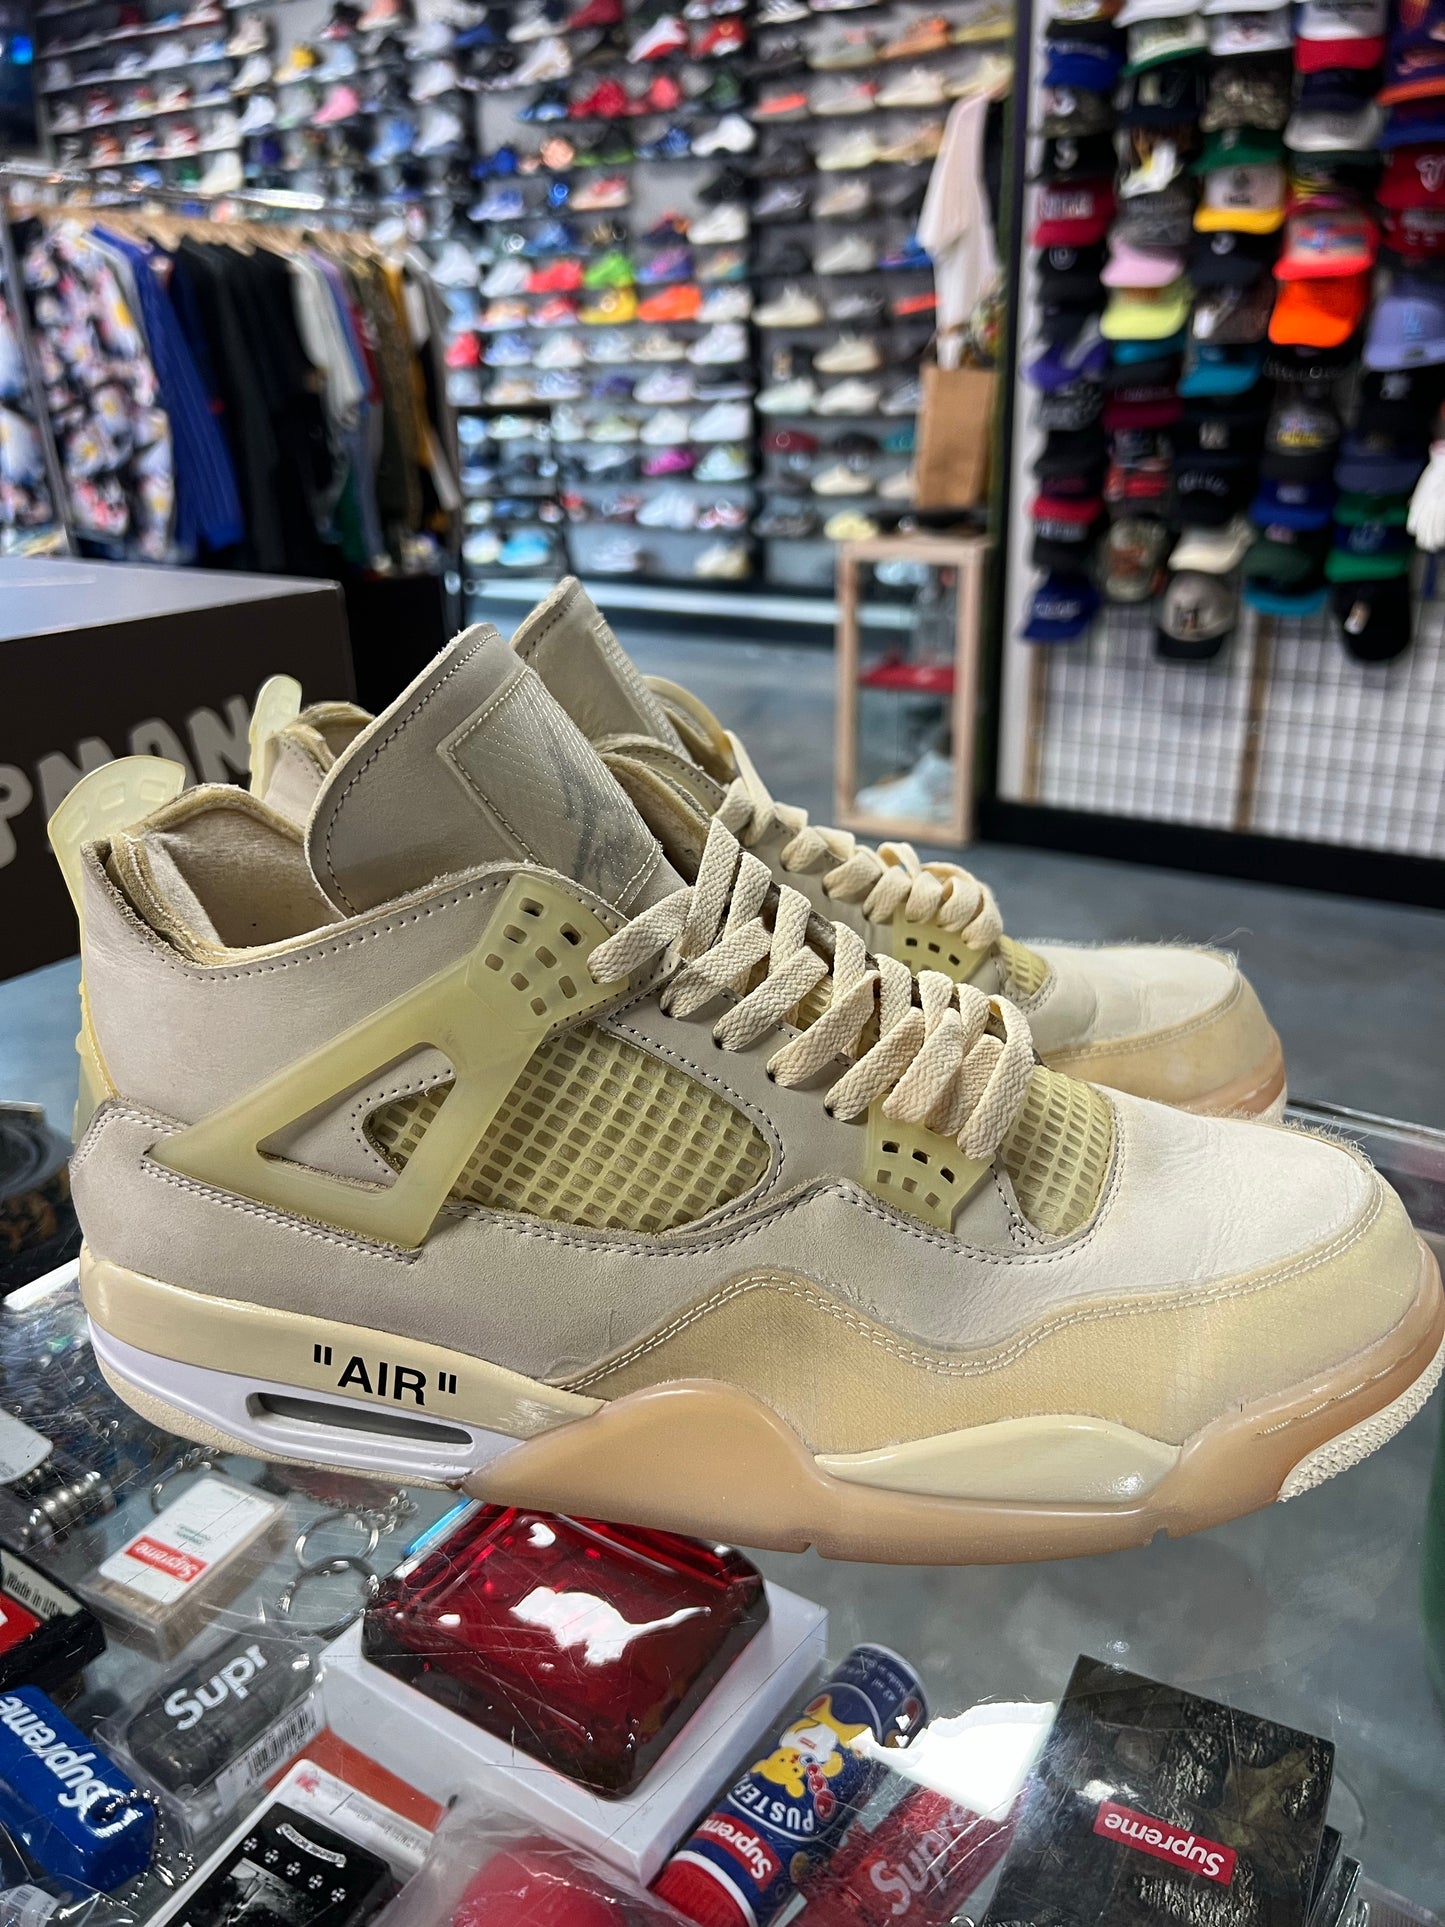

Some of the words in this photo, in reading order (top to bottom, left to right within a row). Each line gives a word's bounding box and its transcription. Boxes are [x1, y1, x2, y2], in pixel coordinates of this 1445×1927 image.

[313, 1343, 457, 1406] "AIR"
[134, 1541, 200, 1577] Supreme
[163, 1644, 269, 1731] Supr
[697, 1819, 773, 1880] Suprem
[1104, 1811, 1225, 1877] Supreme
